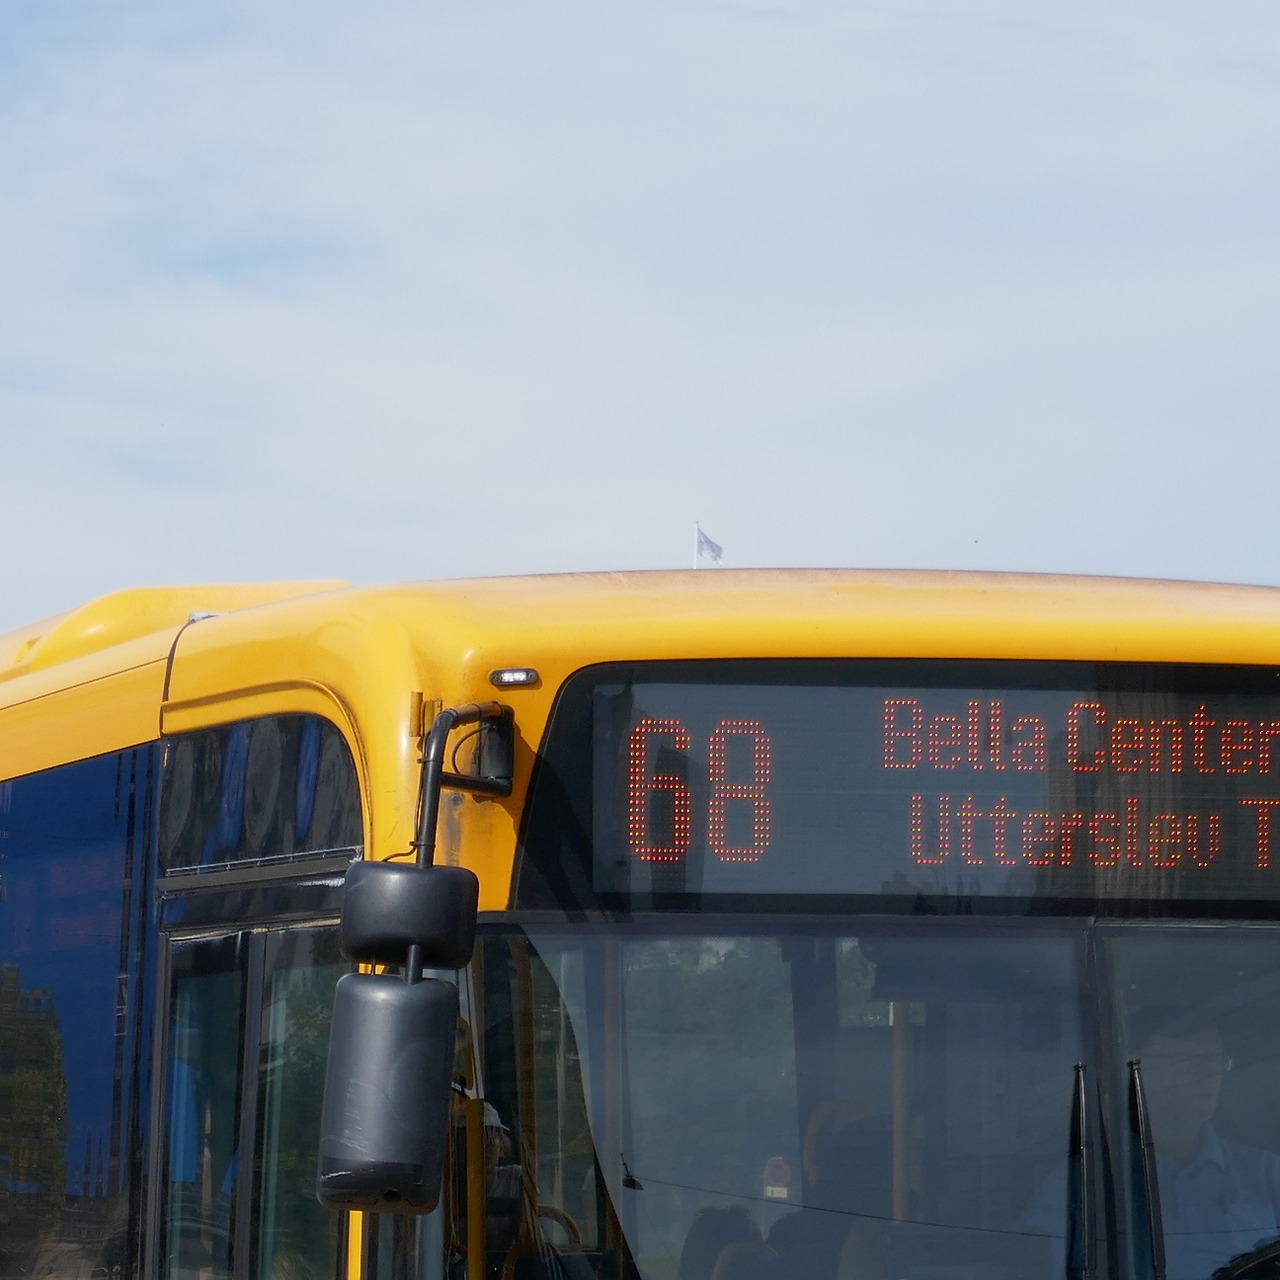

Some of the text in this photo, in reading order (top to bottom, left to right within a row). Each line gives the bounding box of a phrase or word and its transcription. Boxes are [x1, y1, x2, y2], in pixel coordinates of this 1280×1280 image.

[883, 699, 1047, 771] Bella
[628, 717, 772, 863] 68
[910, 795, 1220, 868] Utterslev
